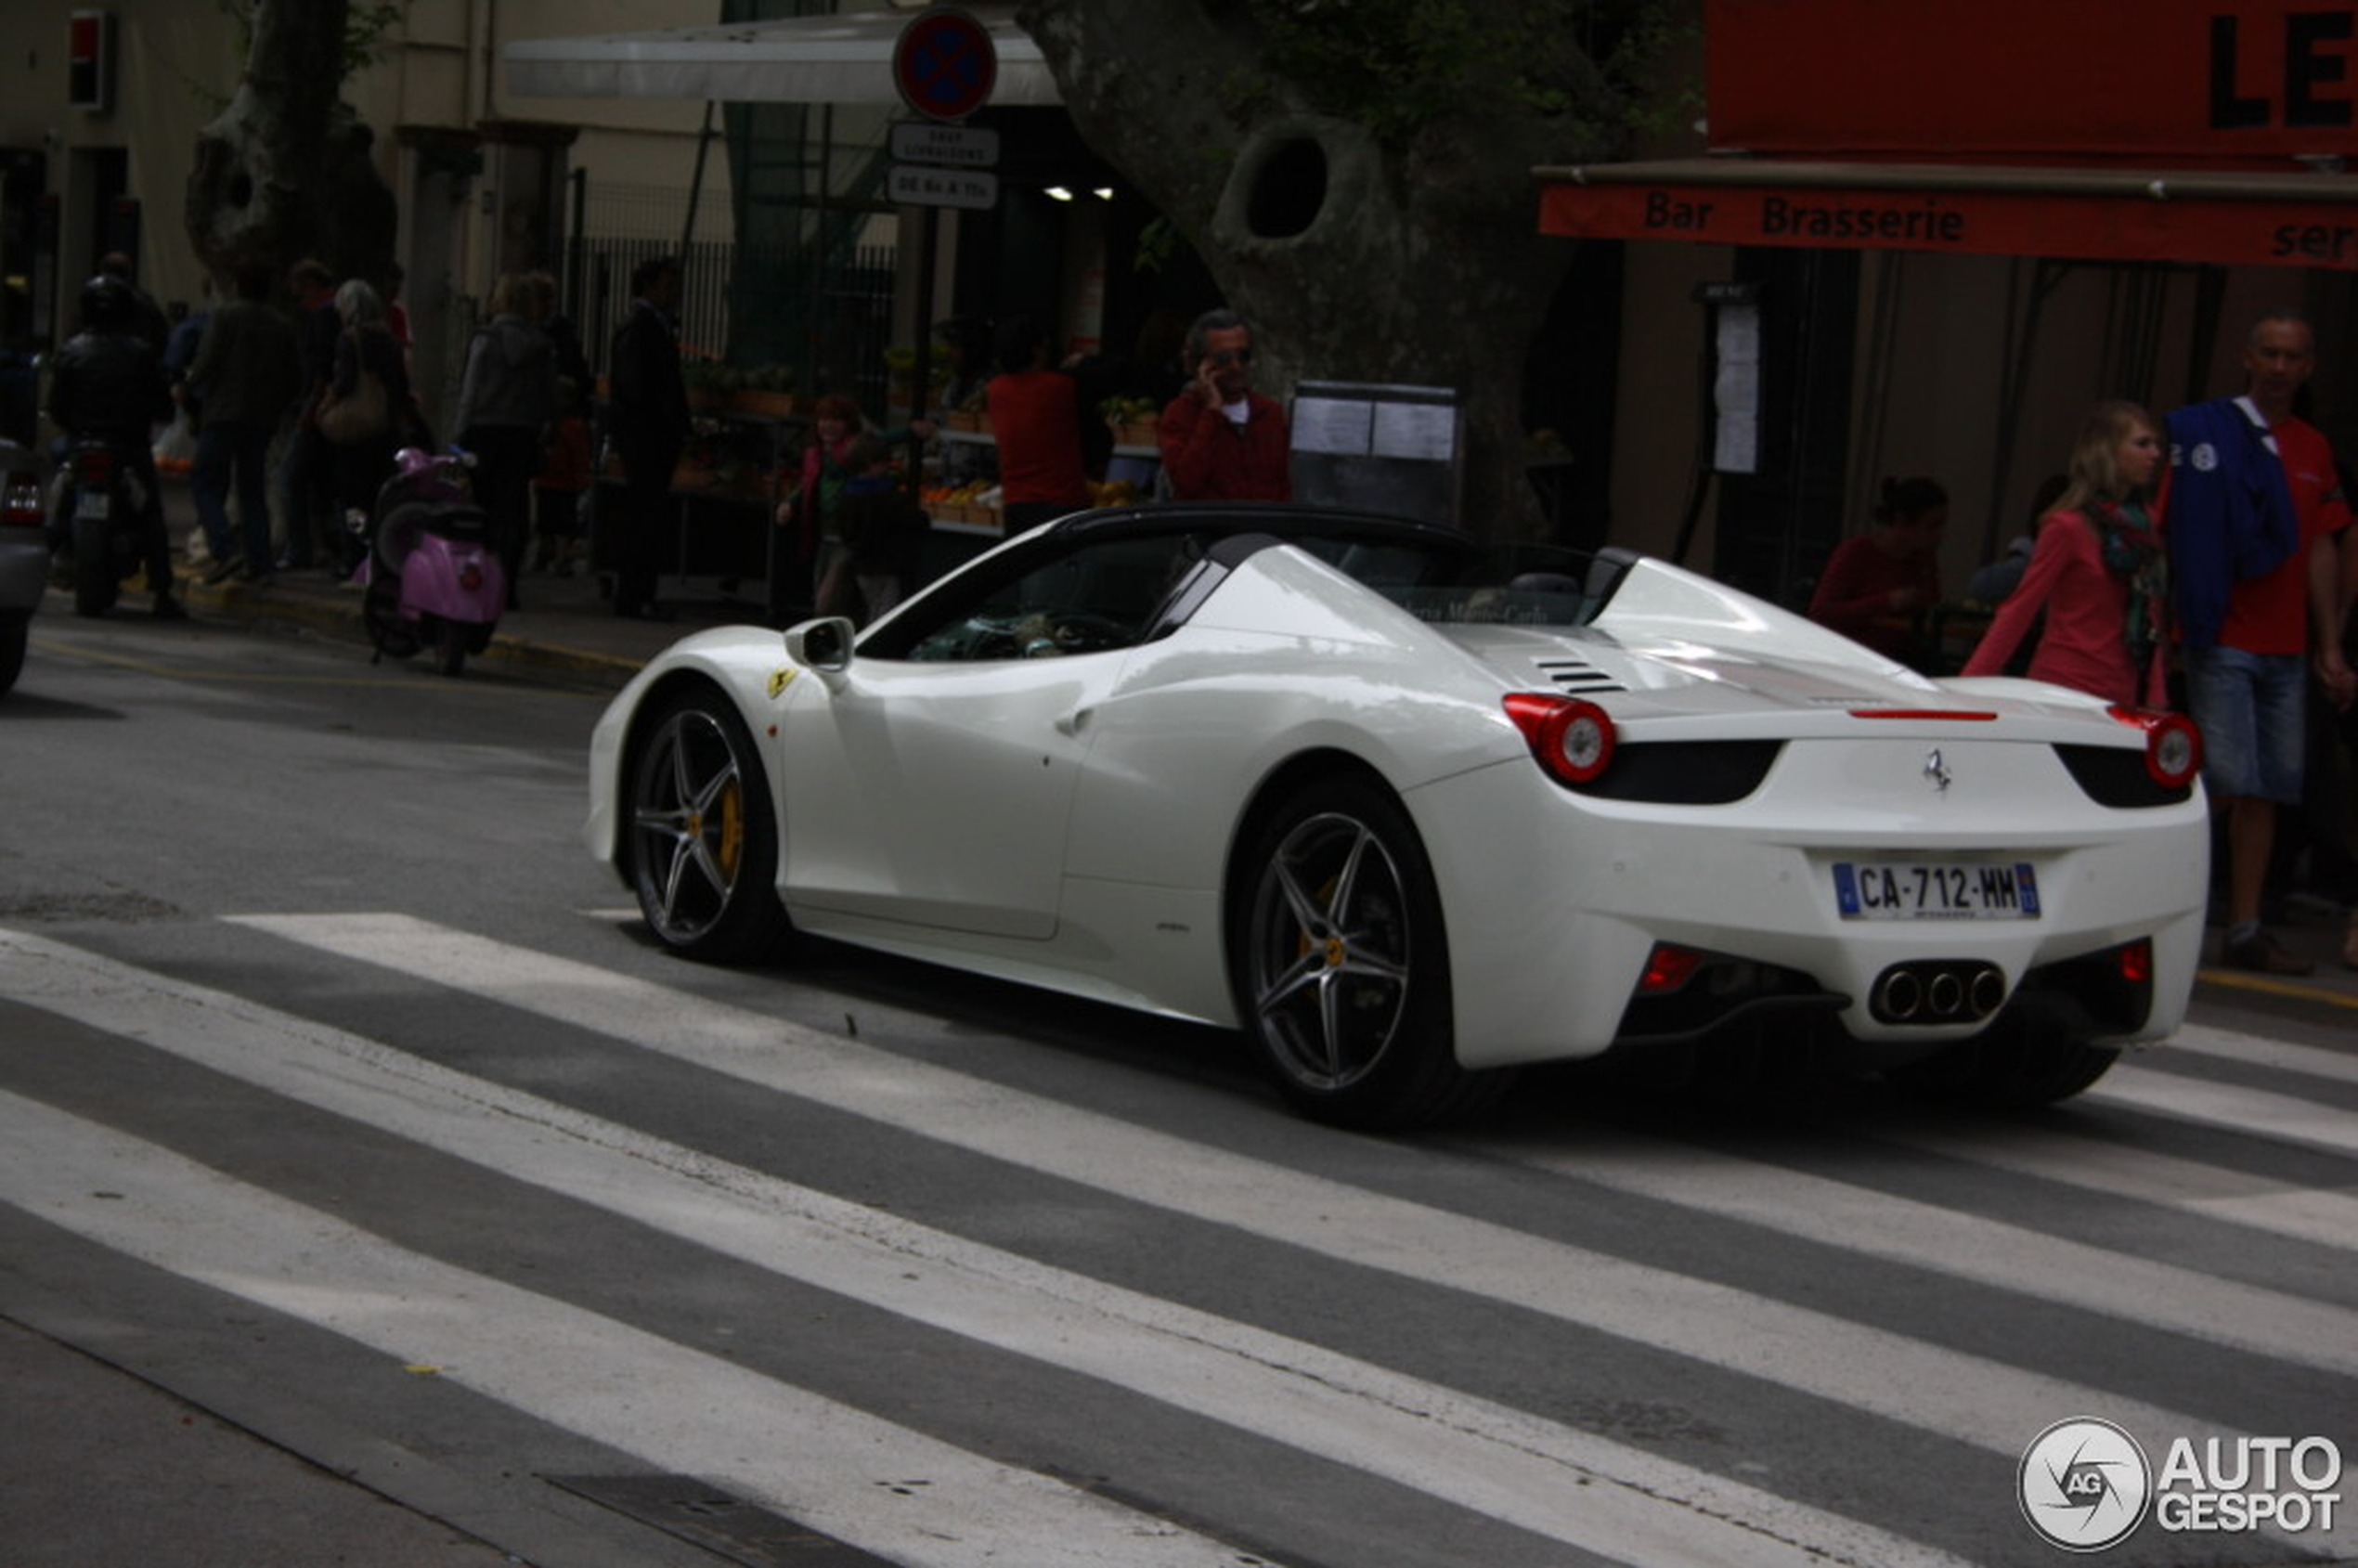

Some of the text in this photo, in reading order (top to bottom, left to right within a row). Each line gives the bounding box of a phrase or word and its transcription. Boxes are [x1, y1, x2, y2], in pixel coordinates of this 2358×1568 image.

[2210, 13, 2353, 127] LE
[1646, 191, 1963, 240] Bar Brasserie
[1860, 867, 2017, 908] CA-712-MM
